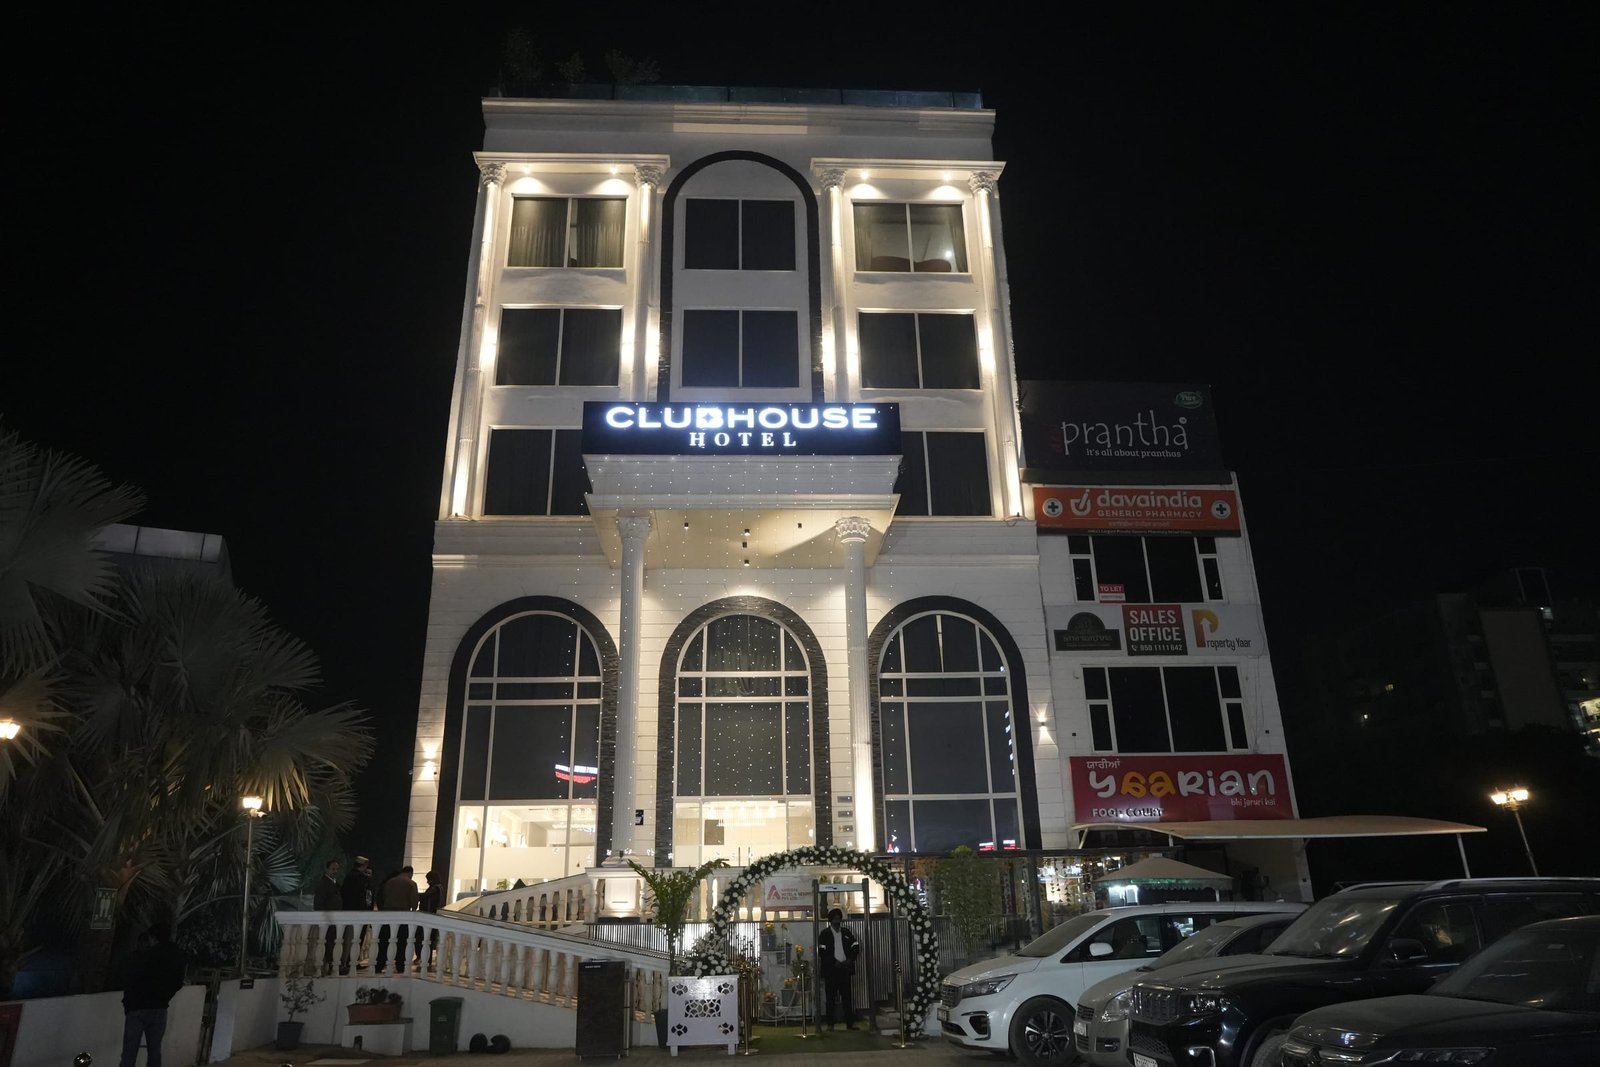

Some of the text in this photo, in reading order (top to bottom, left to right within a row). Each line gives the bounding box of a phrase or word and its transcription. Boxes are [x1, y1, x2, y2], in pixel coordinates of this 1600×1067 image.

[605, 406, 878, 429] CLUBHOUSE
[689, 432, 797, 447] HOTEL
[1060, 410, 1189, 455] prantha
[1101, 448, 1113, 456] all
[1114, 449, 1140, 457] about
[1141, 449, 1181, 459] pranthas
[1097, 490, 1203, 508] davaindia
[1097, 509, 1202, 518] GENERIC PHARMACY
[1130, 610, 1177, 624] SALES
[1129, 627, 1182, 642] OFFICE
